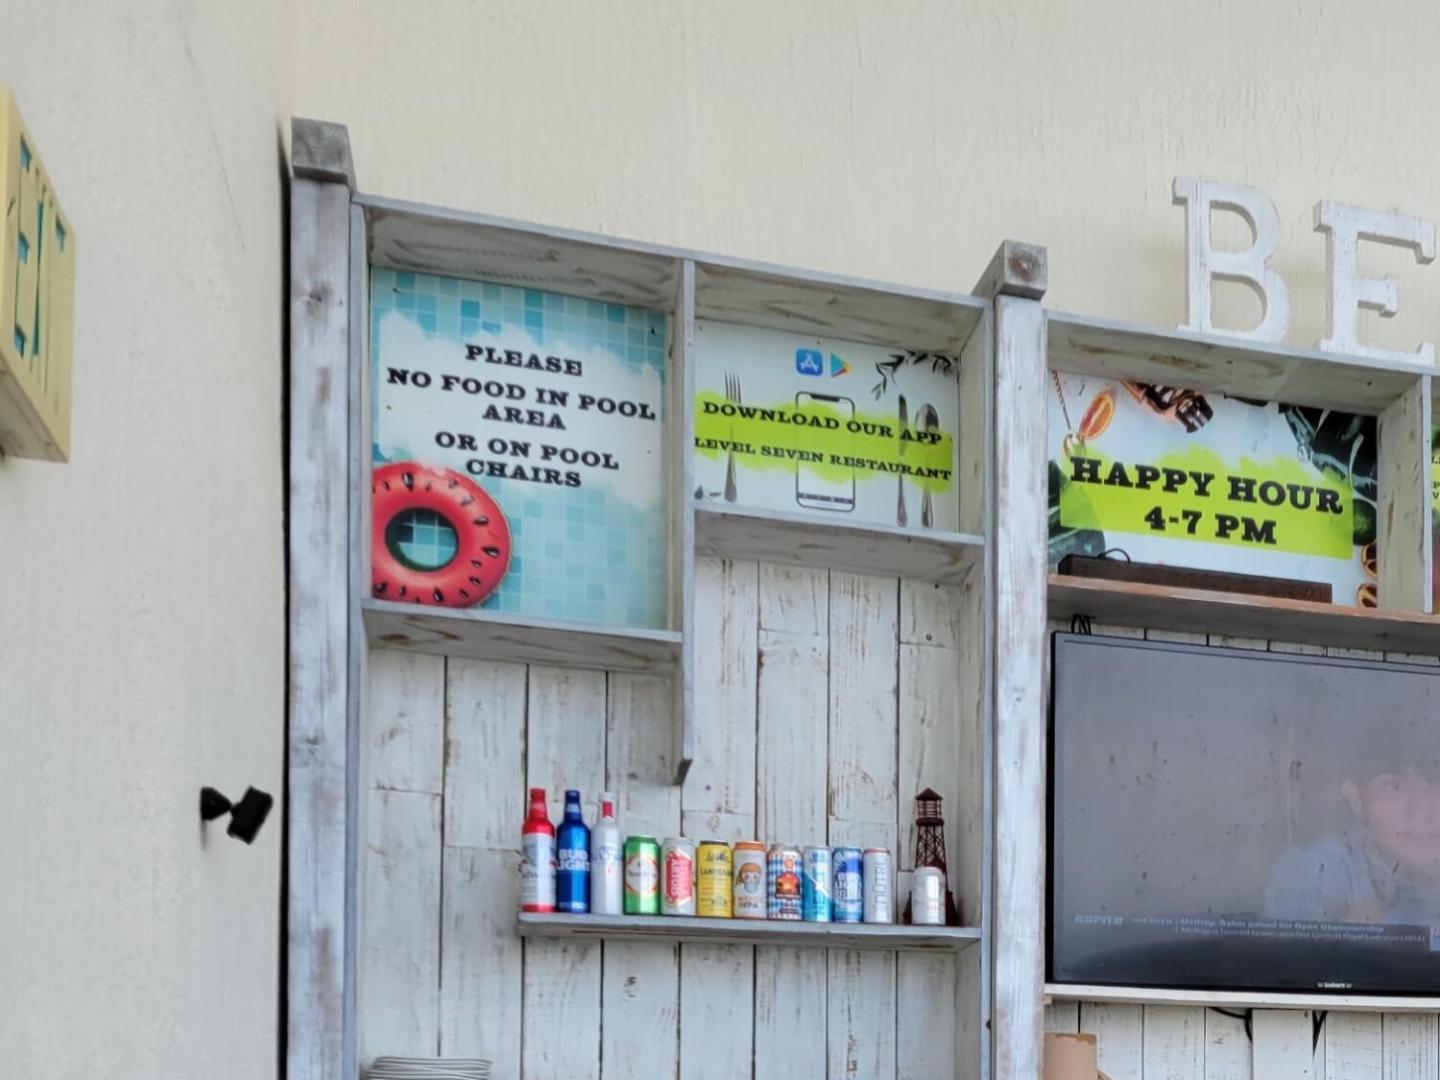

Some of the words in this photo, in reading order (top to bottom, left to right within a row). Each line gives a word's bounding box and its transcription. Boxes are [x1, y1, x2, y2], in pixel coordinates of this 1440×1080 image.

[465, 344, 583, 377] PLEASE
[387, 367, 432, 388] NO
[441, 374, 526, 401] FOOD
[535, 387, 570, 407] IN
[578, 394, 656, 420] POOL
[482, 404, 566, 430] AREA
[703, 401, 840, 430] DOWNLOAD
[846, 421, 894, 438] OUR
[900, 430, 942, 445] APP
[434, 432, 478, 451] OR
[488, 438, 532, 458] ON
[540, 445, 619, 470] POOL
[694, 437, 756, 455] LEVEL
[761, 445, 824, 463] SEVEN
[830, 455, 951, 480] RESTAURANT
[466, 458, 582, 488] CHAIRS
[1070, 456, 1215, 497] HAPPY
[1227, 475, 1343, 514] HOUR
[1145, 505, 1202, 535] 4-7
[1215, 513, 1277, 545] PM
